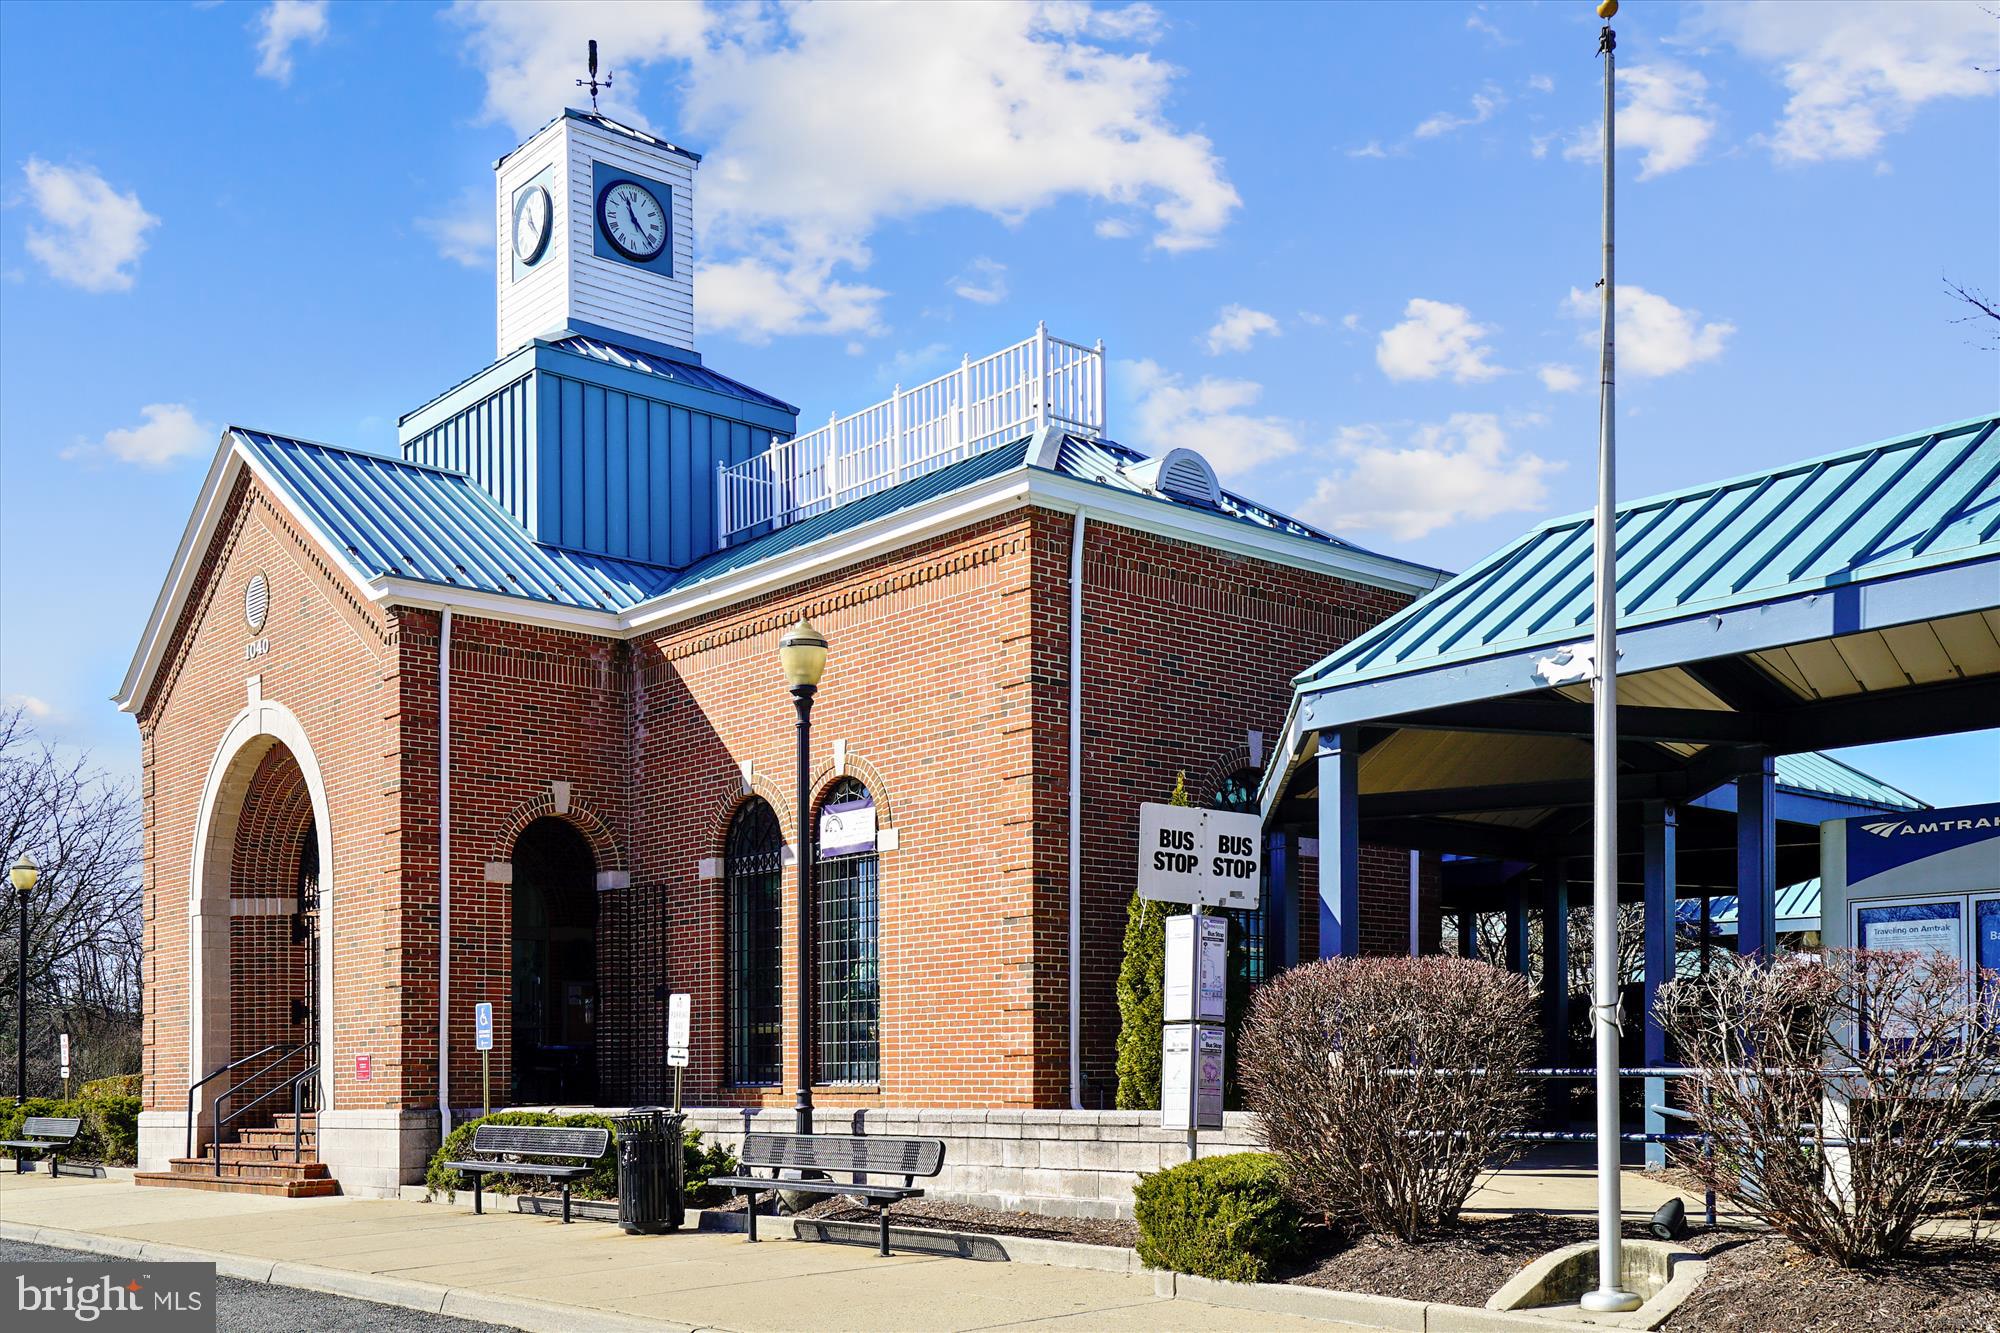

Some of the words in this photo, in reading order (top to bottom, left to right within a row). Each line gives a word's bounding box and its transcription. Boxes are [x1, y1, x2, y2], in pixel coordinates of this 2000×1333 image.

[246, 639, 270, 660] 1040
[1159, 828, 1195, 851] BUS
[1218, 834, 1253, 857] BUS
[1153, 851, 1199, 874] STOP
[1212, 857, 1257, 879] STOP
[1873, 926, 1907, 935] Traveling
[1920, 924, 1951, 932] Amtrak
